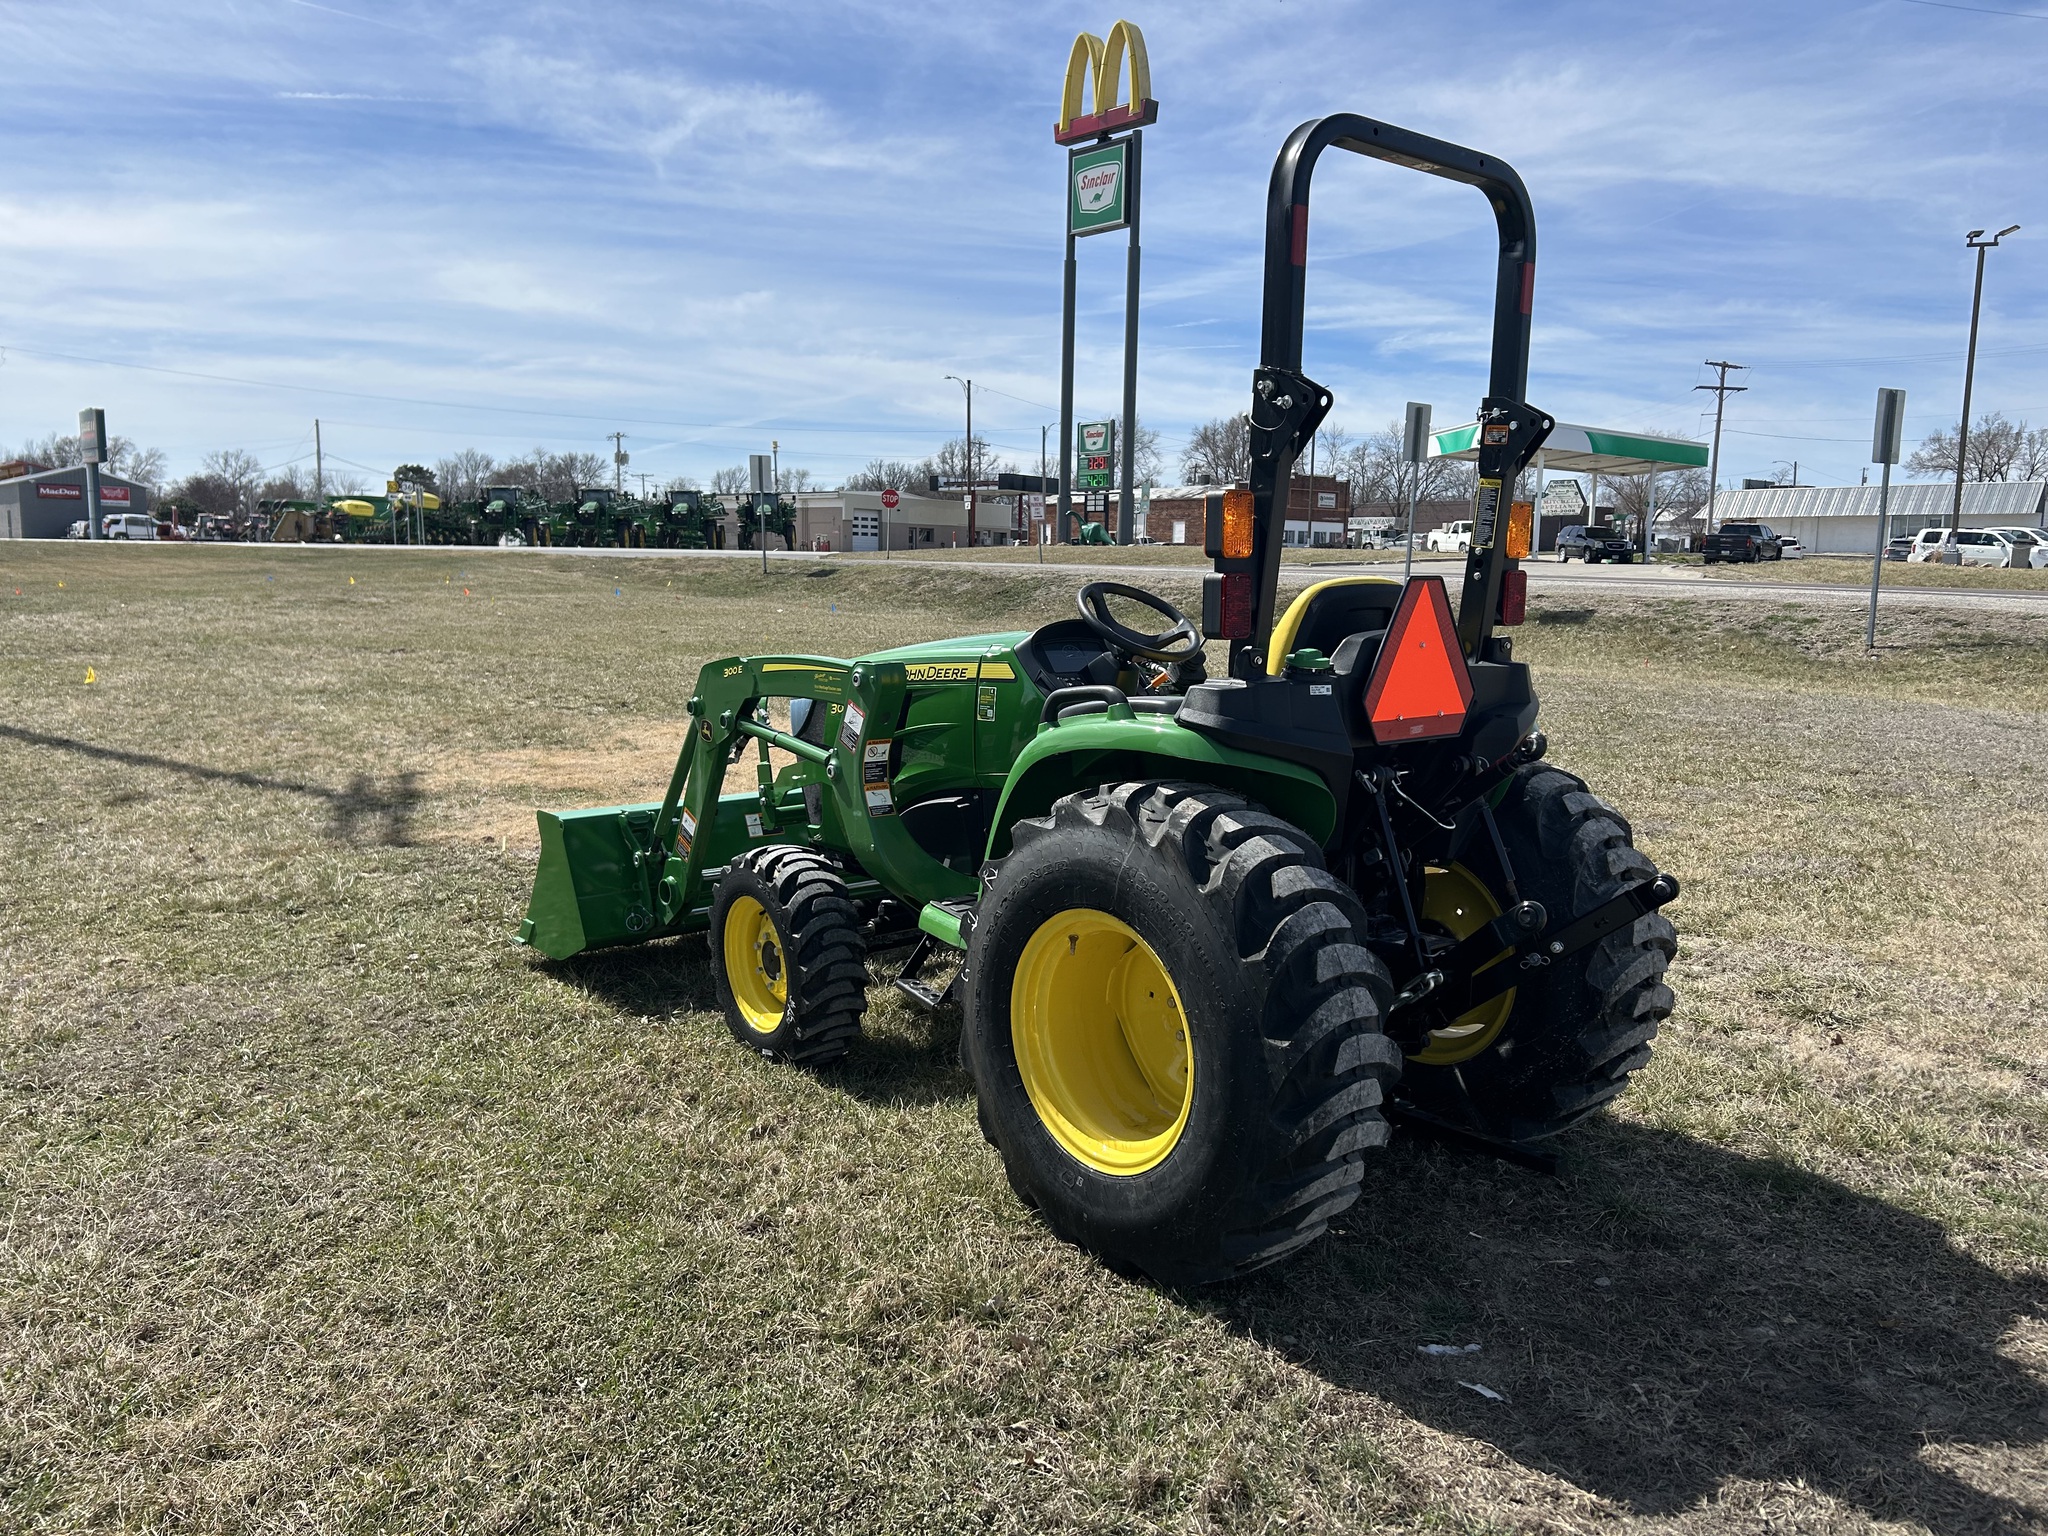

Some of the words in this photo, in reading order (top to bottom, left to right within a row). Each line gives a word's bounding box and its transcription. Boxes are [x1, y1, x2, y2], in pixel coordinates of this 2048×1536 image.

[1081, 171, 1116, 191] Sinclair
[1086, 430, 1104, 439] Sinclair
[40, 487, 79, 496] MacDon
[882, 494, 899, 503] STOP
[926, 666, 968, 680] DEERE
